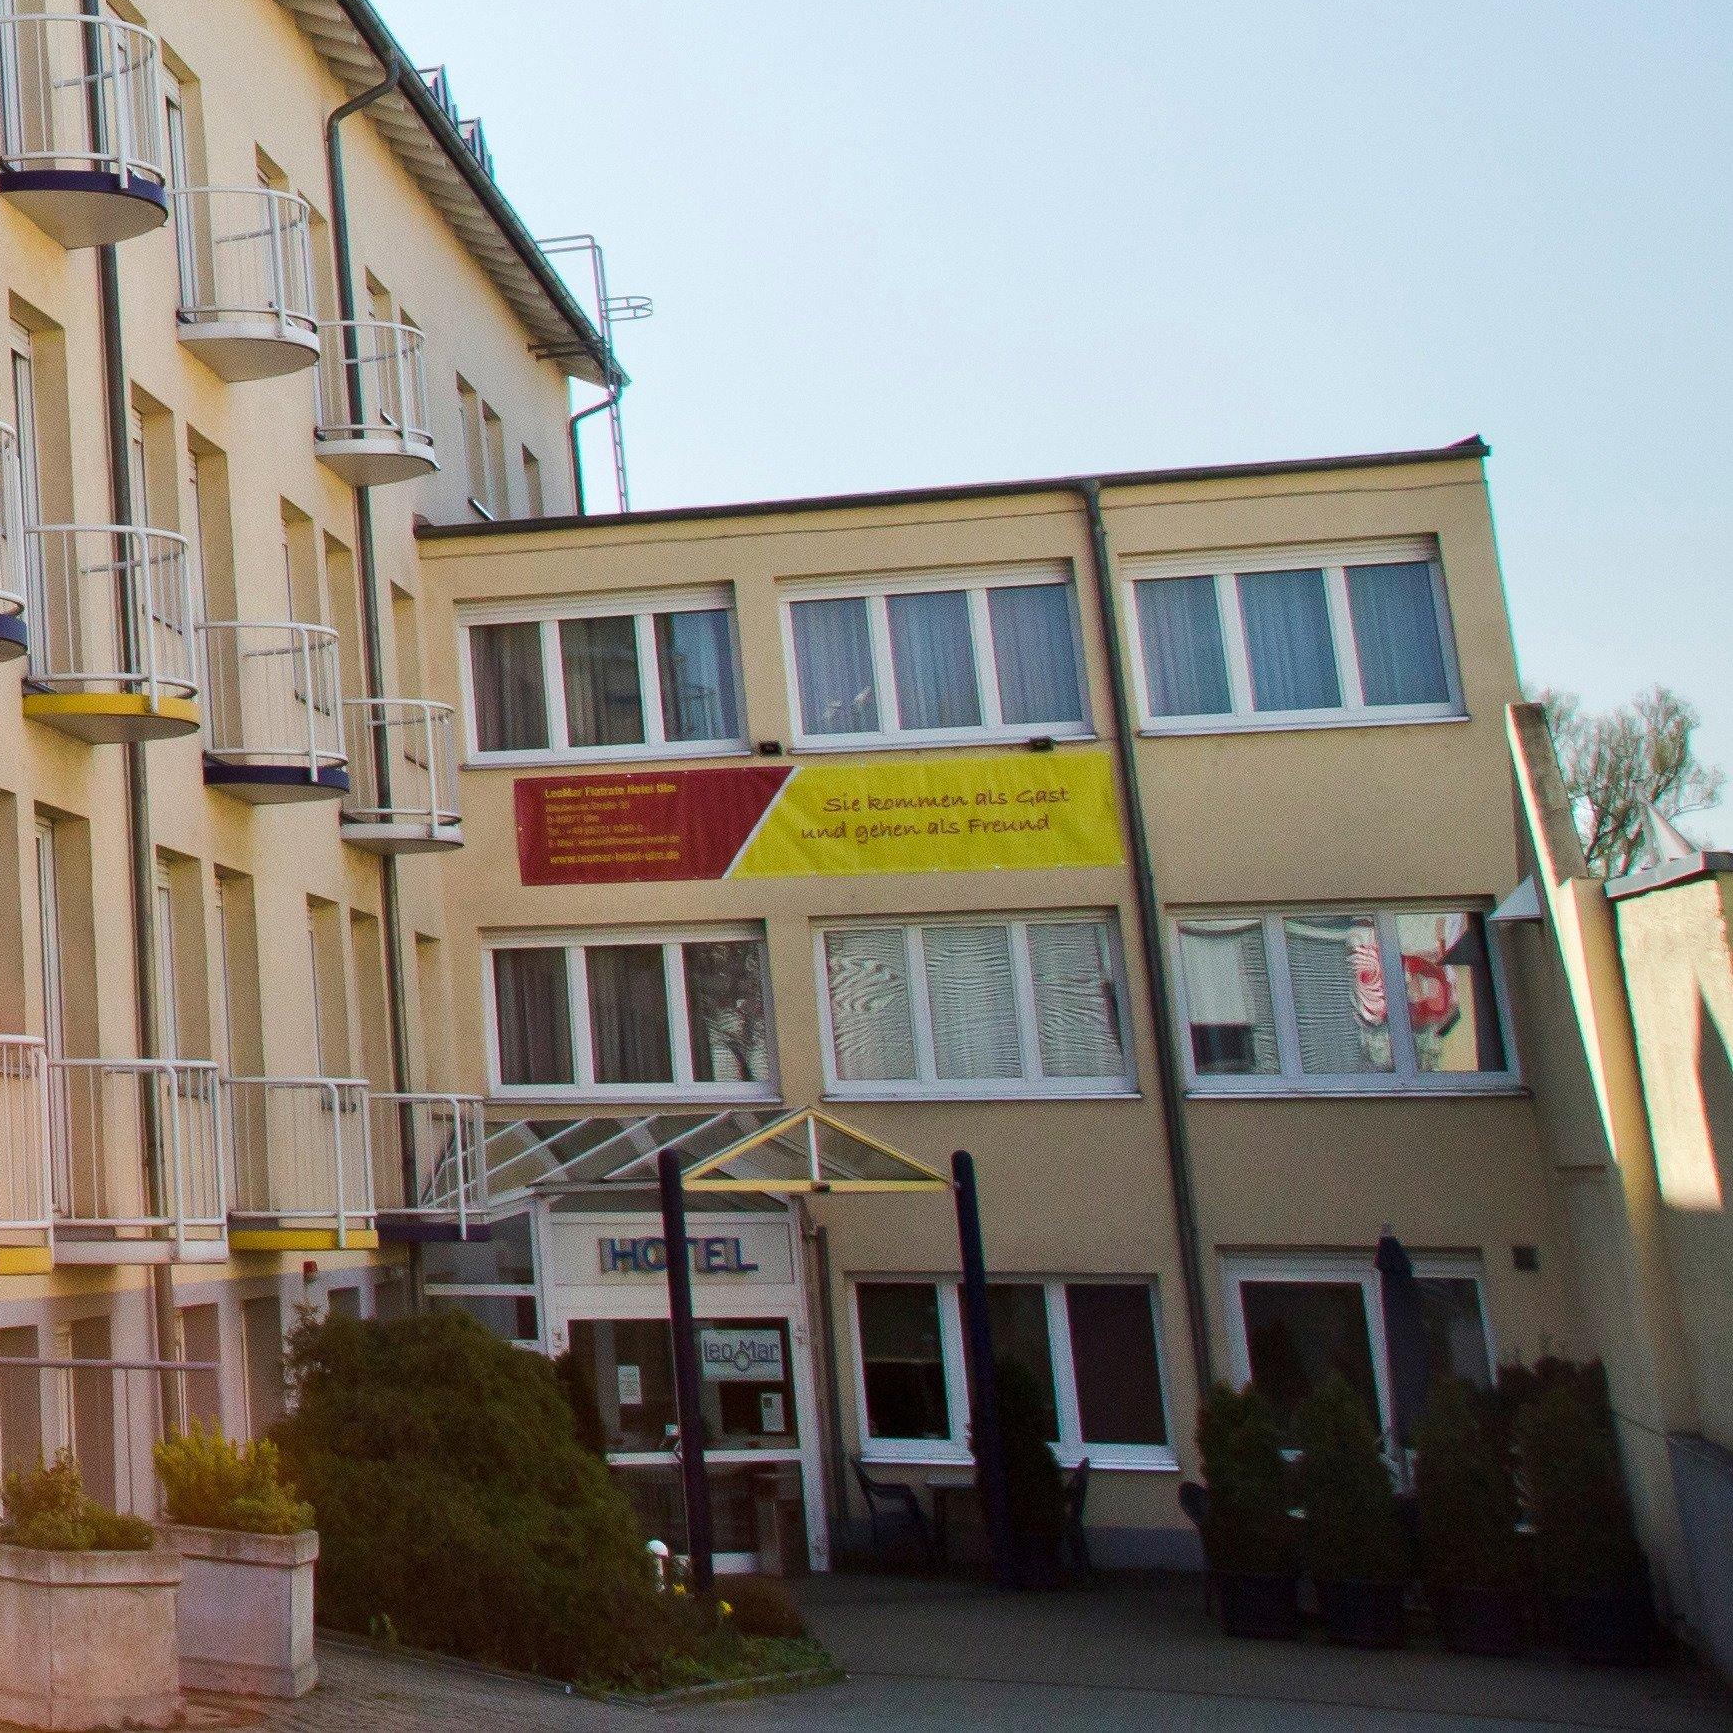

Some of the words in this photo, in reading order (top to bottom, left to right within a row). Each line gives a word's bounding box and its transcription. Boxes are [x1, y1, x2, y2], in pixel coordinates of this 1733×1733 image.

[822, 793, 861, 813] Sie
[867, 792, 968, 810] kommen
[975, 789, 1008, 806] als
[1015, 787, 1071, 805] Gast
[801, 821, 847, 841] und
[855, 821, 920, 845] gehen
[926, 817, 961, 835] als
[967, 813, 1051, 834] Freund
